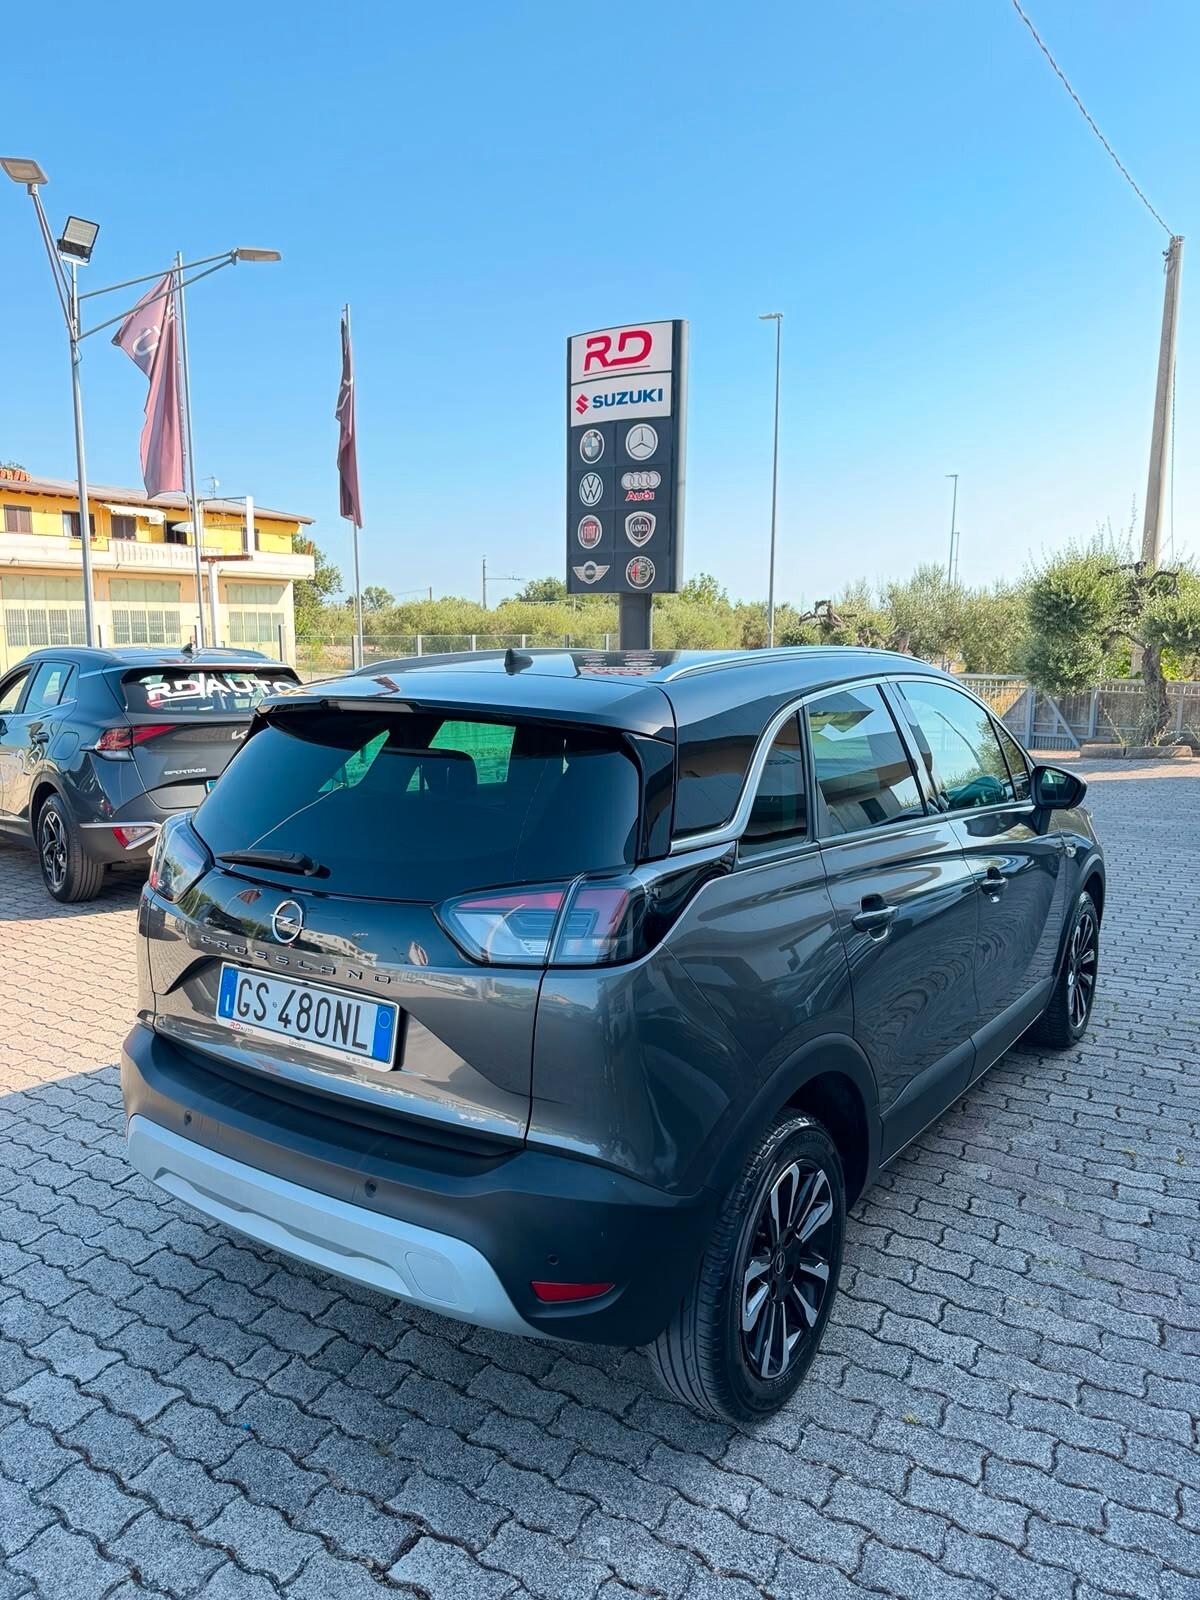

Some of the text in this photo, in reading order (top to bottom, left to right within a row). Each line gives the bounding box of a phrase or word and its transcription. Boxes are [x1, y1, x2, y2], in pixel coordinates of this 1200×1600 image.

[584, 330, 653, 372] RD
[592, 388, 663, 409] SUZUKI
[625, 490, 655, 501] Audi
[200, 934, 392, 984] CROSSLAND
